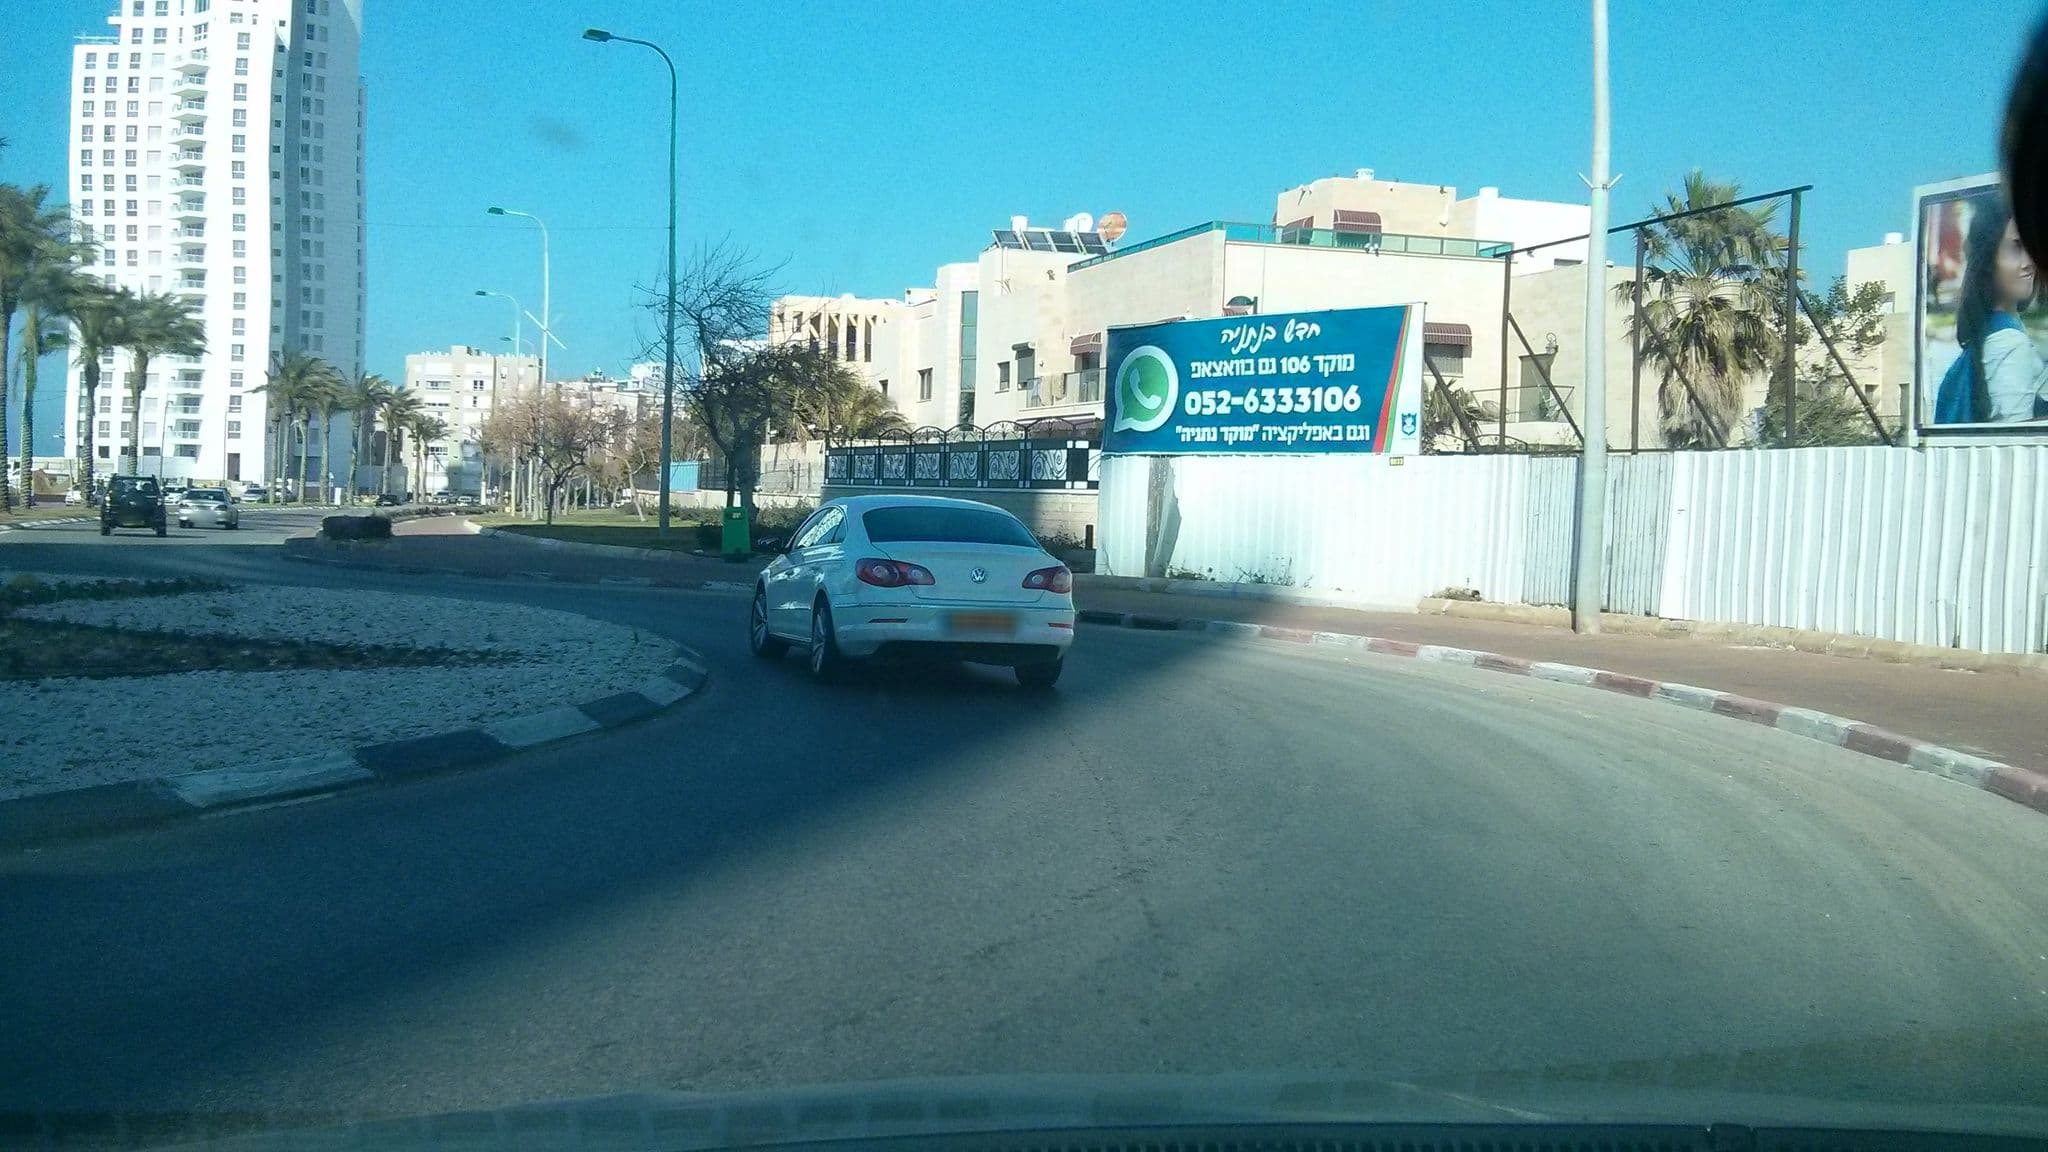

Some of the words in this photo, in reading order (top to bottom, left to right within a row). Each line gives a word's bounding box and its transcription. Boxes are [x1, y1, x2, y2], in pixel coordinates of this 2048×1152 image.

[1220, 322, 1277, 355] בנתניה
[1283, 318, 1321, 344] חדש
[1258, 357, 1277, 375] גם
[1279, 355, 1311, 375] 106
[1312, 353, 1356, 378] מוקד
[1184, 384, 1362, 416] 052-6333106
[1261, 421, 1344, 446] באפליקציה
[1346, 424, 1371, 441] וגם
